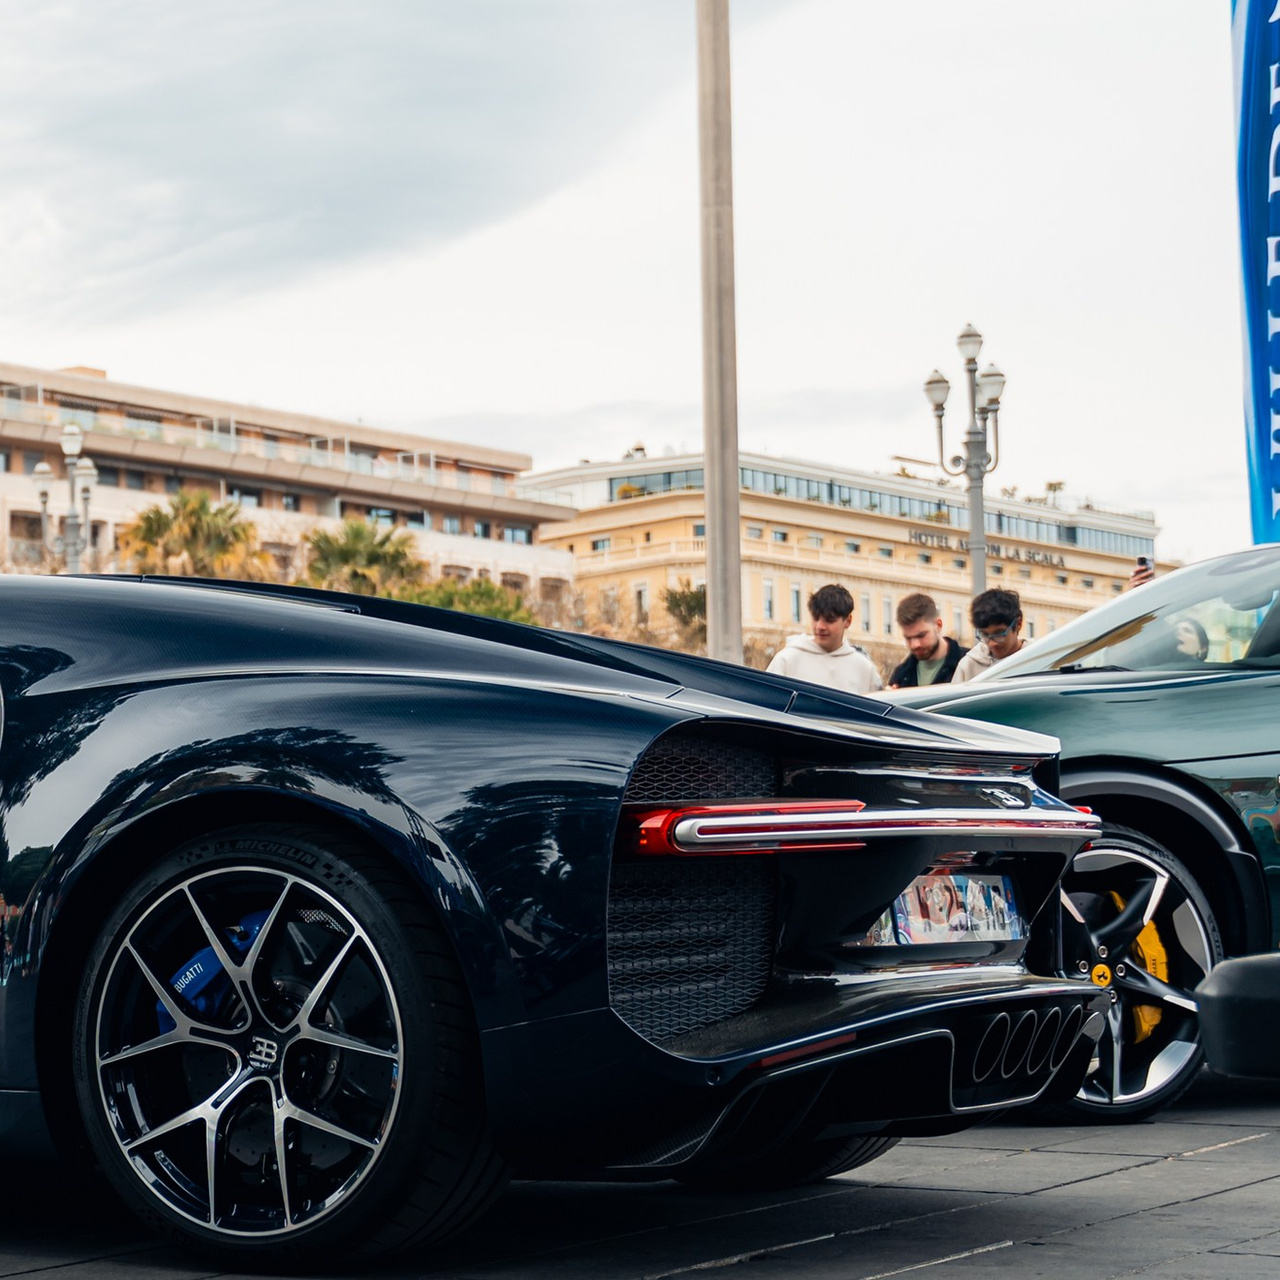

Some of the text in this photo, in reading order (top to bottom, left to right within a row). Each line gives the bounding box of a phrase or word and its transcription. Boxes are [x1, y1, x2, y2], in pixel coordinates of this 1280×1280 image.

[908, 530, 953, 548] HOTEL
[1025, 550, 1065, 568] SCALA
[234, 839, 318, 867] MICHELIN
[173, 962, 204, 994] BUGATTI
